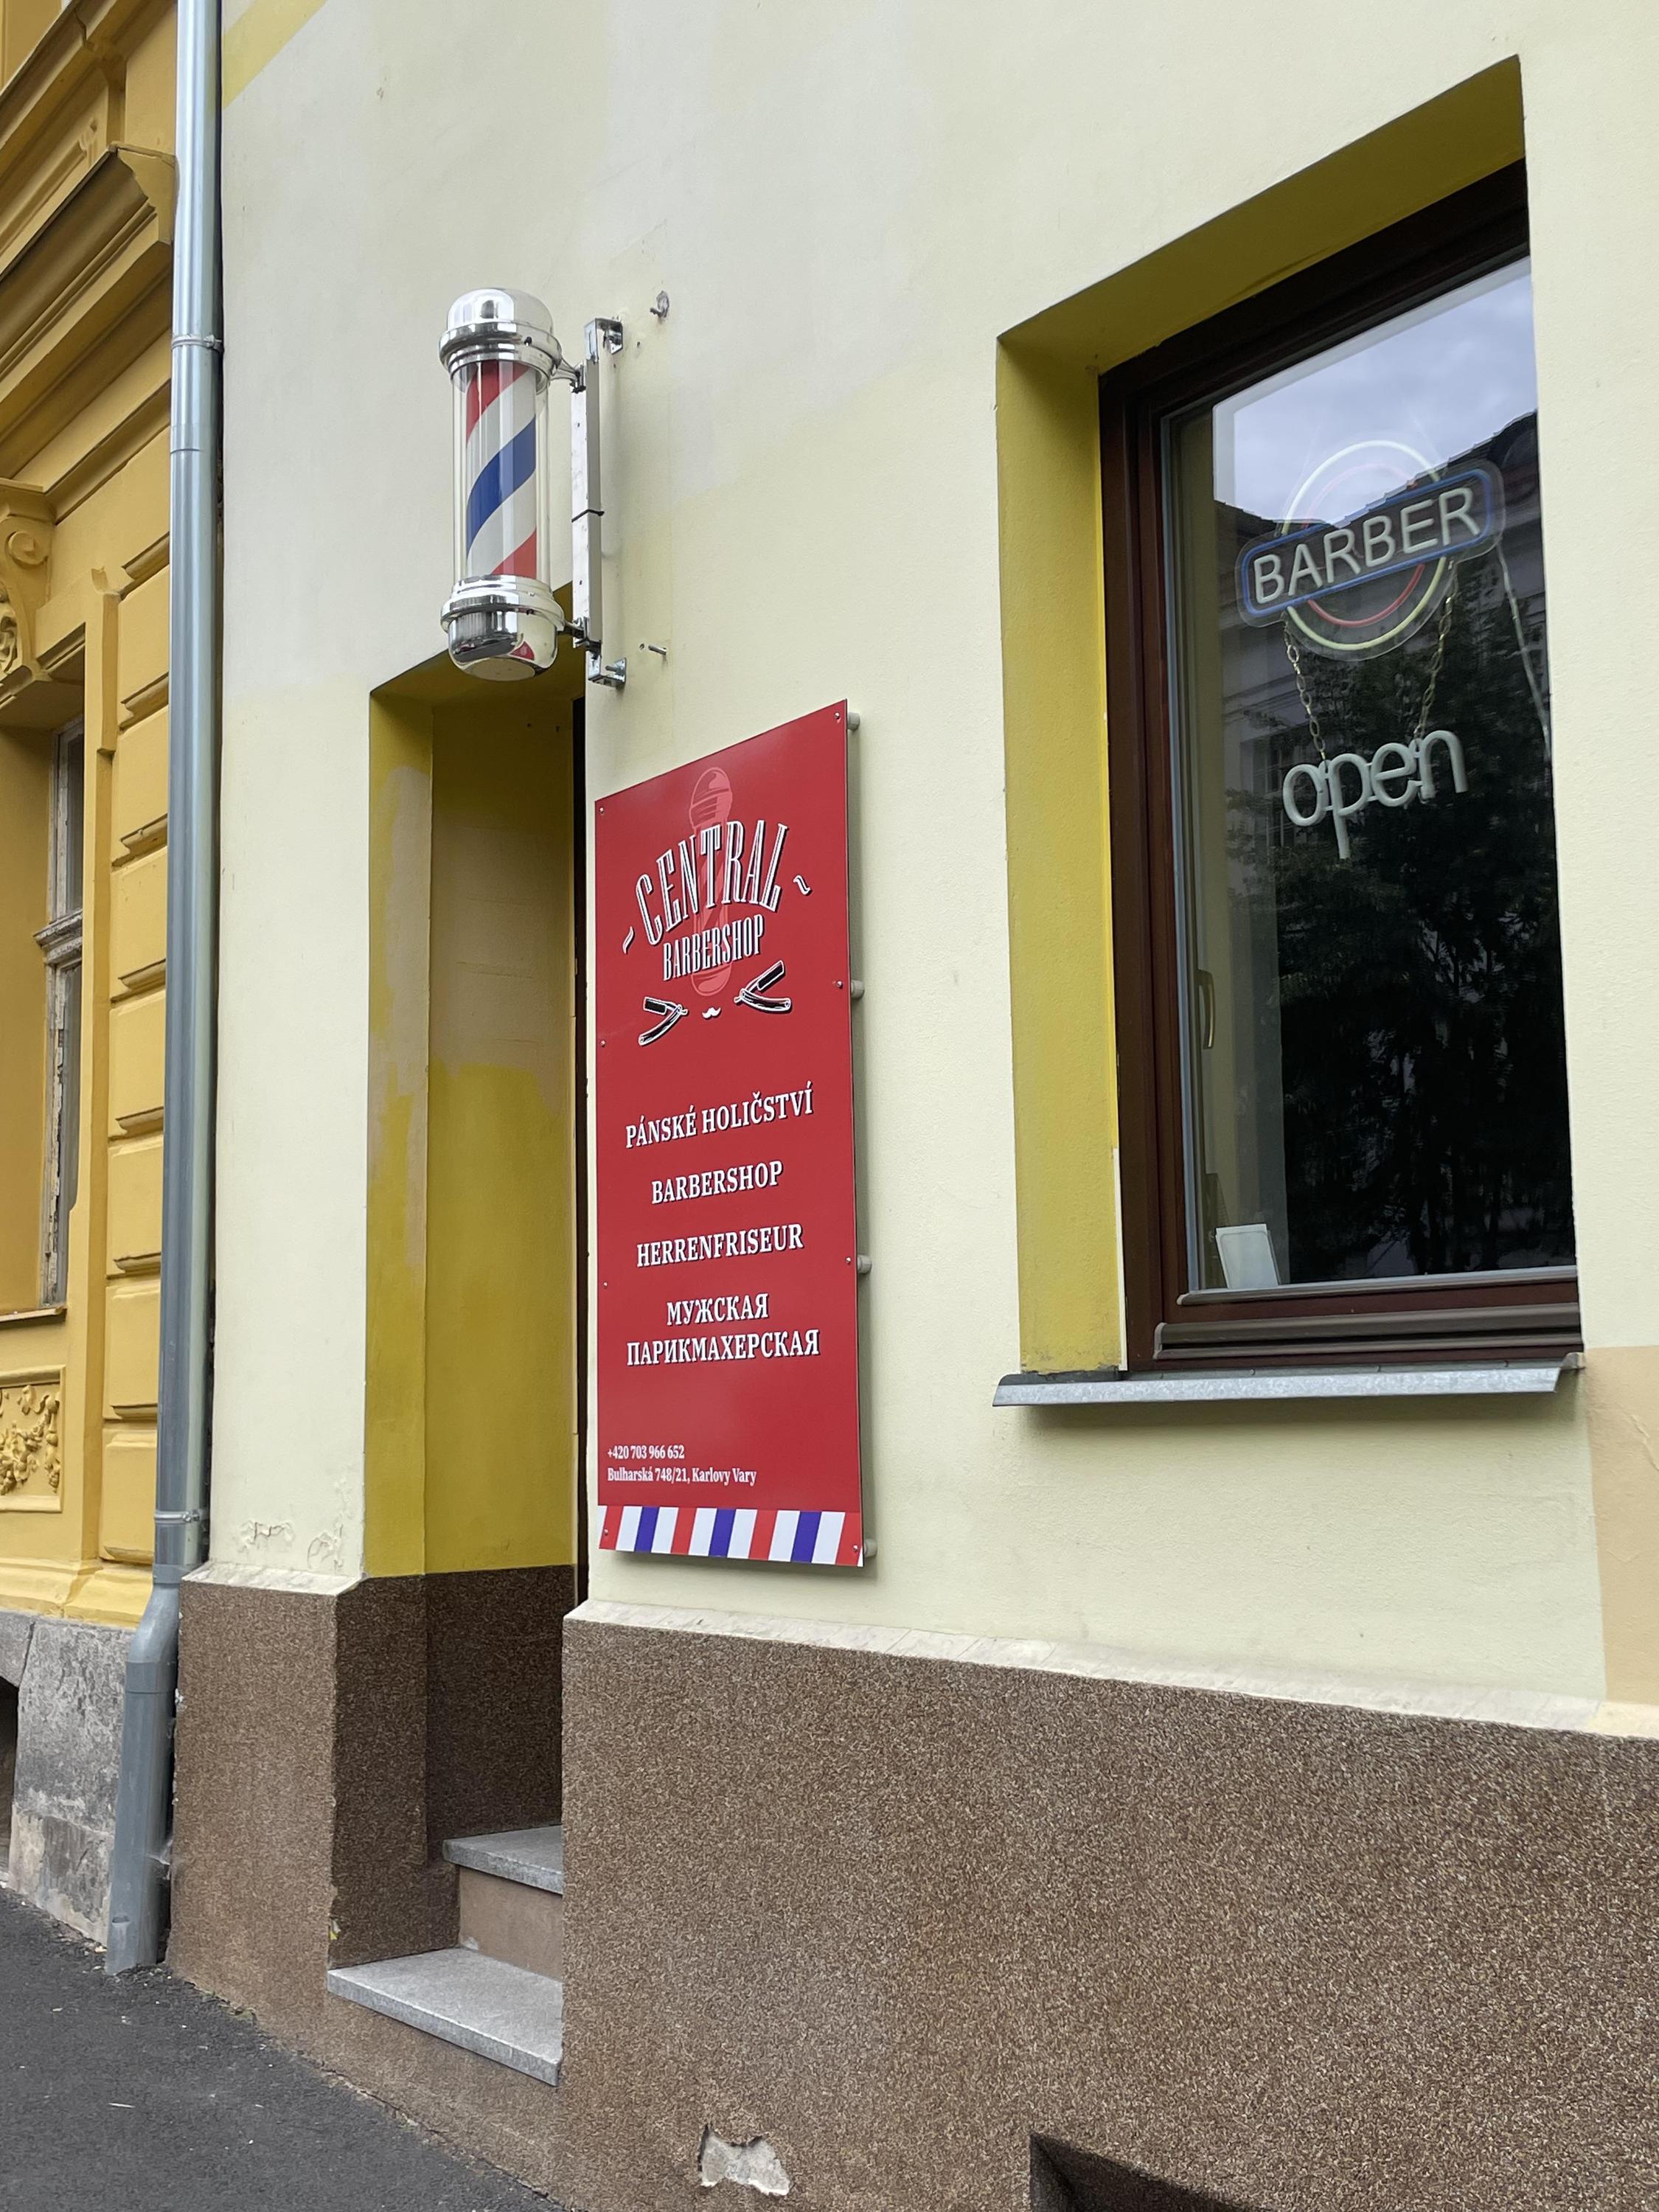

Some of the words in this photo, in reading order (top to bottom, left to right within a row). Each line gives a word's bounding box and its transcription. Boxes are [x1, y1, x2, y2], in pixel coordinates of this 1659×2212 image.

[1253, 487, 1481, 605] BARBER
[1282, 729, 1469, 860] open
[636, 819, 788, 946] CENTRAL
[662, 914, 765, 981] BARBERSHOP
[625, 1105, 697, 1149] PÁNSKÉ
[701, 1080, 814, 1135] HOLIČSTVÍ
[651, 1160, 783, 1205] BARBERSHOP
[636, 1223, 804, 1268] HERRENFRISEUR
[666, 1292, 770, 1326] МУЖСКАЯ
[626, 1329, 820, 1366] ПАРИКМАХЕРСКАЯ
[607, 1445, 629, 1460] +420
[630, 1445, 647, 1459] 703
[648, 1445, 666, 1459] 966
[667, 1444, 685, 1459] 652
[607, 1466, 653, 1482] Bulharská
[655, 1467, 691, 1484] 748/21,
[692, 1467, 731, 1486] Karlovy
[731, 1467, 757, 1486] Vary
